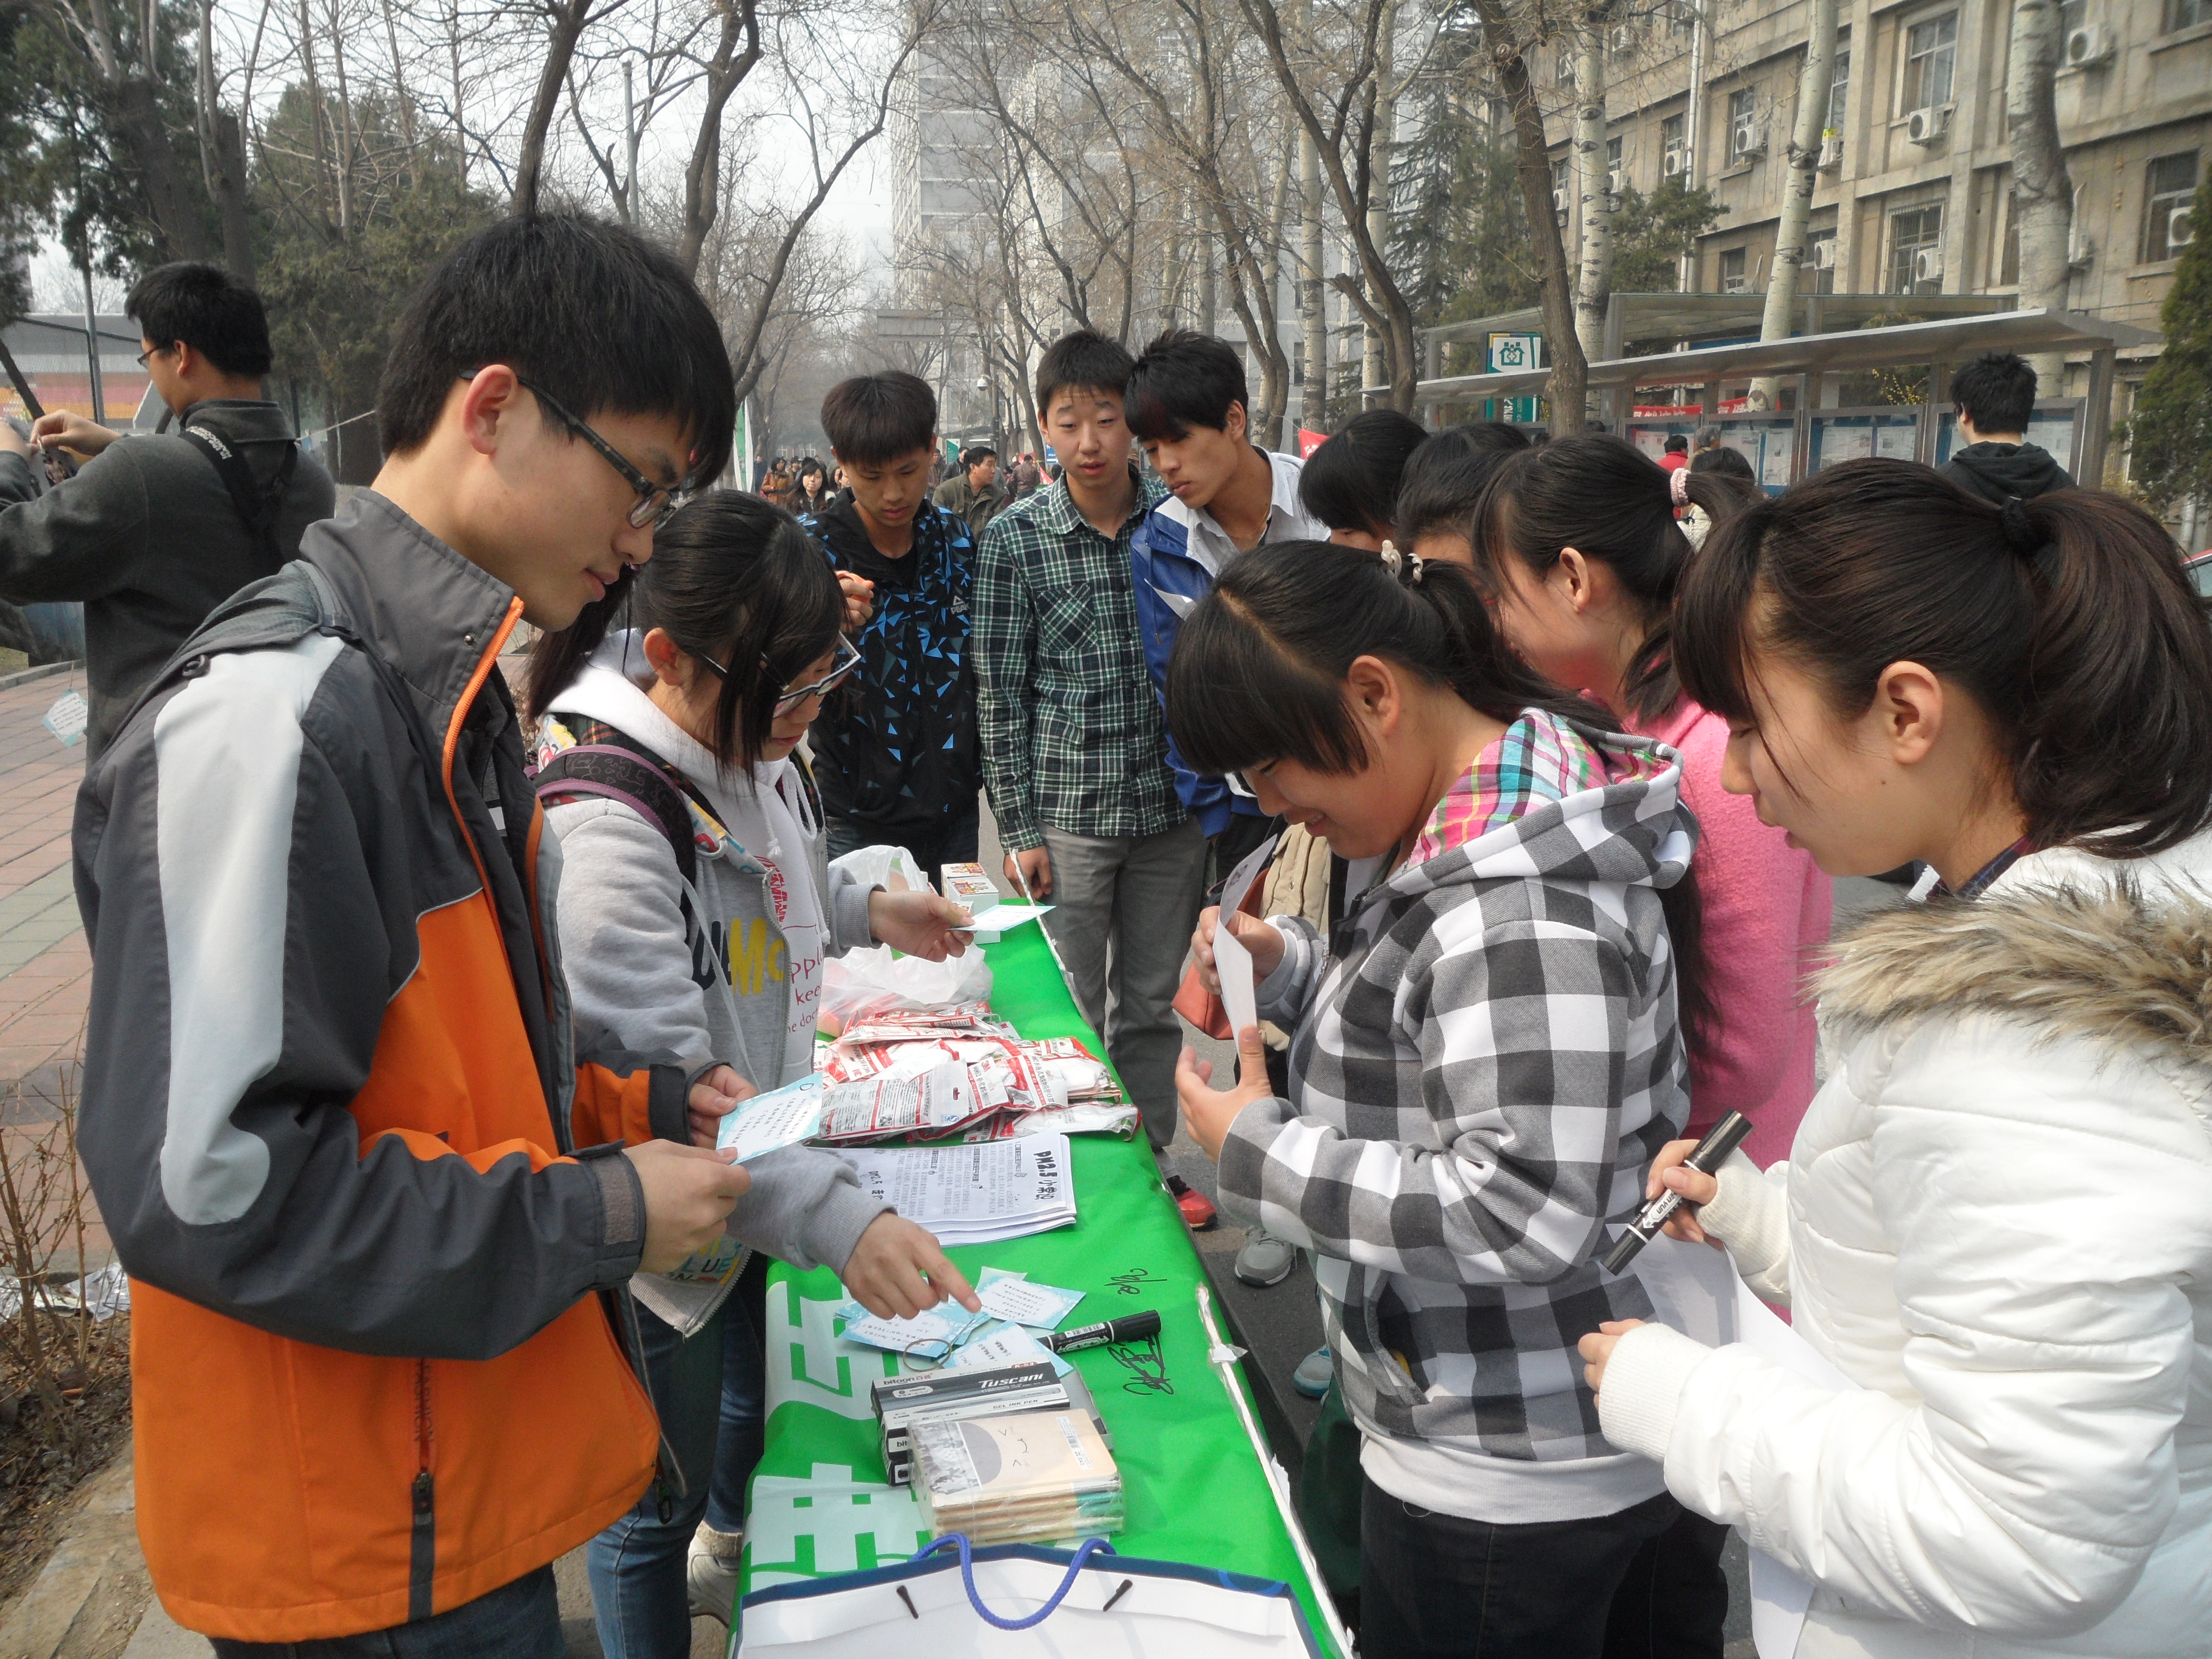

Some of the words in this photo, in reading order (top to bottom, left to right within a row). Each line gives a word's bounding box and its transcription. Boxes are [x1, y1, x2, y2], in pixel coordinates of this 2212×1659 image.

[982, 1060, 991, 1072] 3M
[1033, 1150, 1057, 1177] PM2.5
[1033, 1180, 1057, 1200] 小常识
[883, 1377, 915, 1385] bitoon
[979, 1373, 1044, 1389] Tuscani
